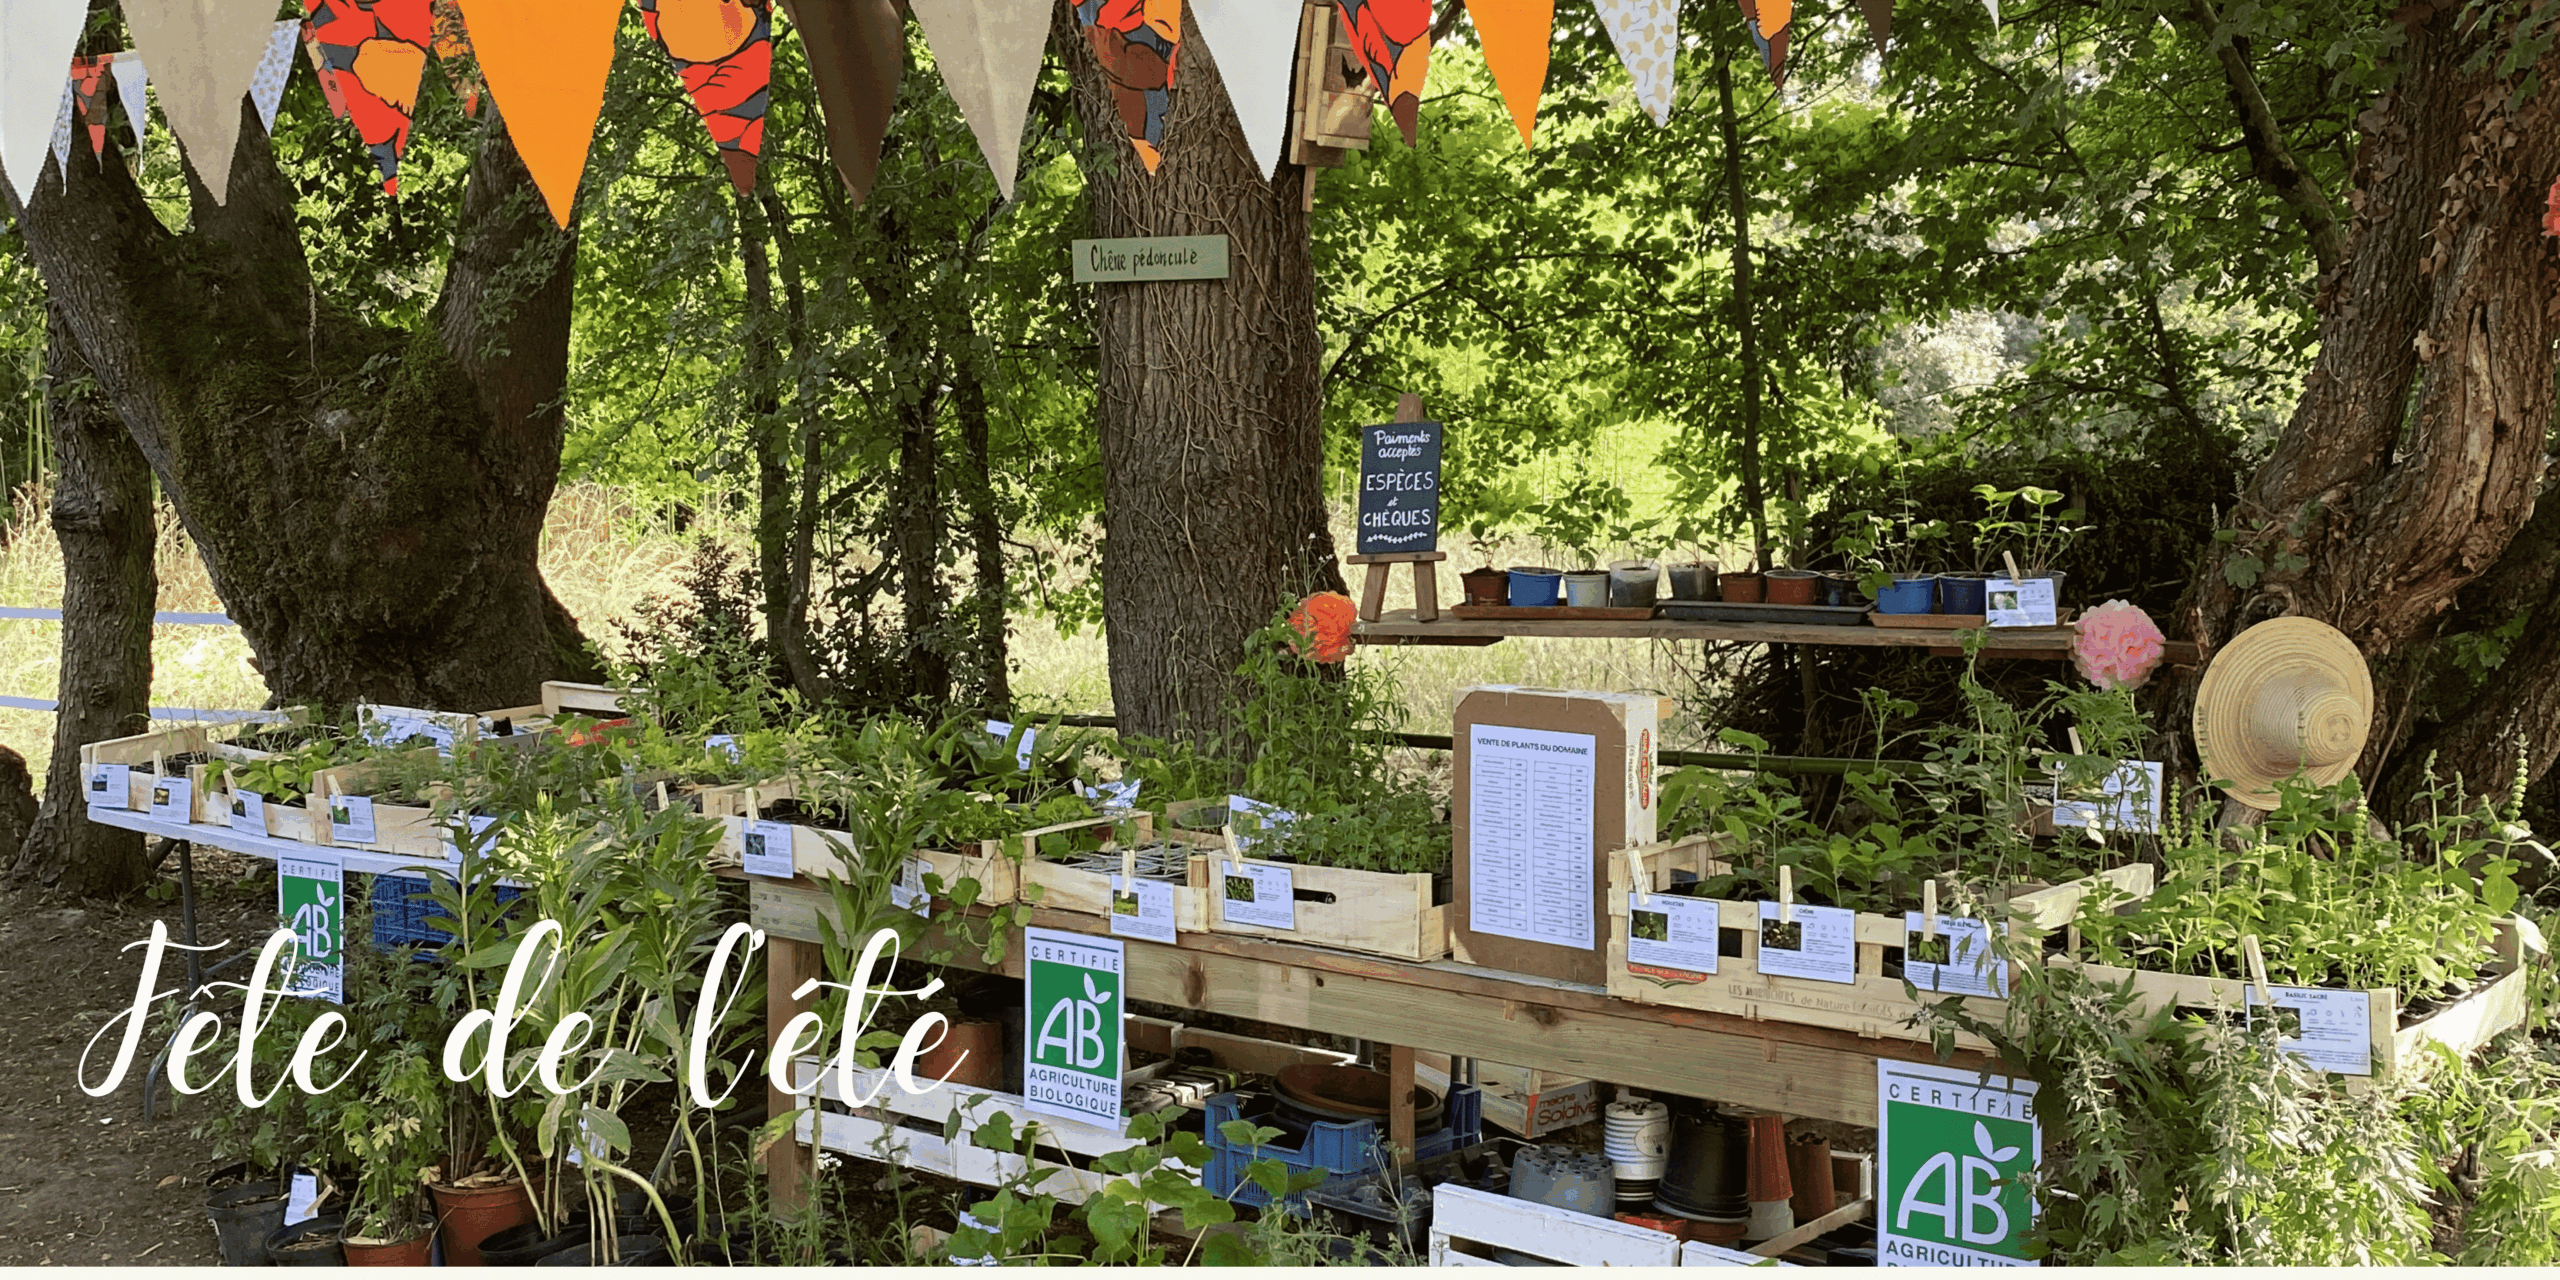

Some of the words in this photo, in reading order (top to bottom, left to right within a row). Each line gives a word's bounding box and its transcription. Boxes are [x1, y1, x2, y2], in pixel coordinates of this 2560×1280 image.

[1090, 244, 1127, 272] Chêne
[1377, 444, 1422, 462] acceptés
[1366, 468, 1434, 491] ESPÈCES
[1386, 496, 1399, 507] et
[1477, 737, 1500, 747] VENTE
[1501, 739, 1511, 748] DE
[1511, 741, 1540, 751] PLANTS
[1540, 744, 1551, 752] DU
[1552, 745, 1588, 756] DOMAINE
[289, 902, 332, 959] AB
[1031, 945, 1119, 972] CERTIFIÉ
[1036, 997, 1105, 1069] AB
[1029, 1067, 1117, 1097] AGRICULTURE
[1030, 1085, 1117, 1115] BIOLOGIQUE
[1537, 1101, 1599, 1126] Soldive
[1896, 1151, 2009, 1245] AB
